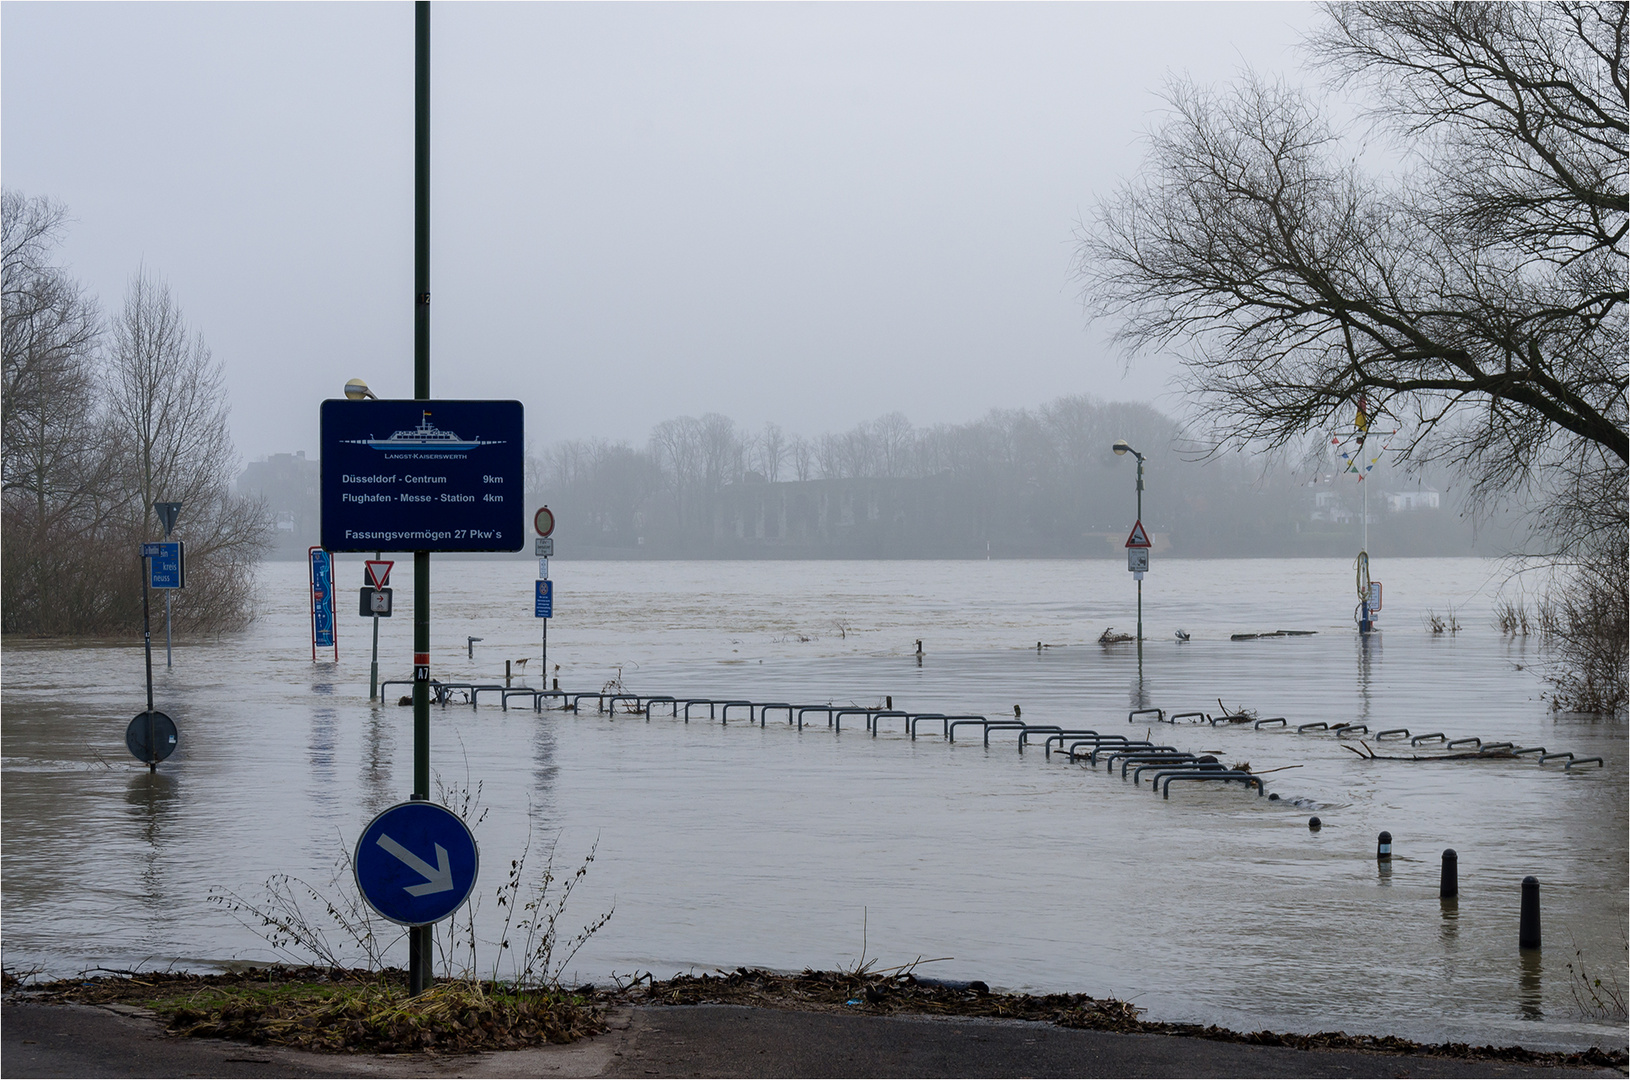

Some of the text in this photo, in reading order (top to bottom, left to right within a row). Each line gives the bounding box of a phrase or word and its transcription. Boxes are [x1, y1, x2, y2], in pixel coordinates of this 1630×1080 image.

[342, 474, 397, 484] Düsseldorf
[404, 475, 447, 484] Centrum
[482, 475, 504, 484] 9km
[342, 493, 392, 505] Flughafen
[400, 493, 432, 503] Messe
[440, 493, 475, 503] Station
[482, 493, 504, 503] 4km
[345, 529, 452, 542] Fassungsvermögen
[454, 529, 467, 539] 27
[163, 562, 177, 571] kreis
[418, 667, 429, 680] A7
